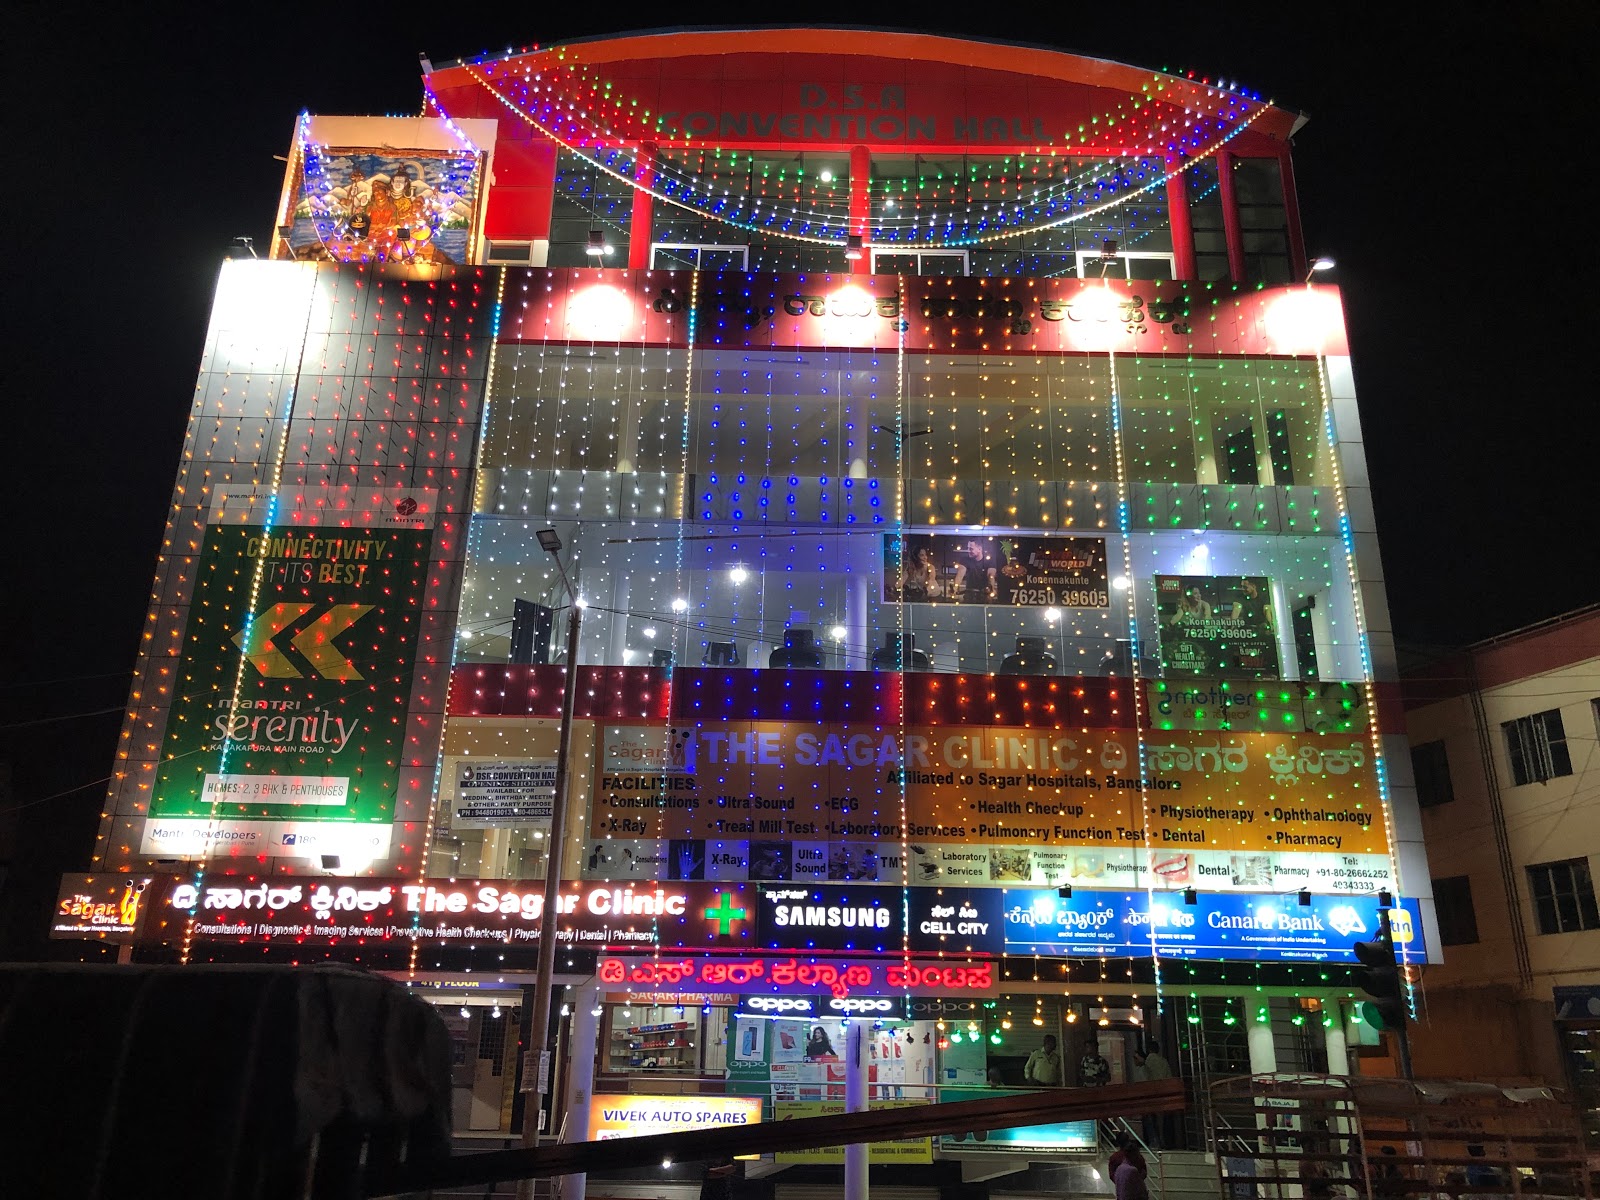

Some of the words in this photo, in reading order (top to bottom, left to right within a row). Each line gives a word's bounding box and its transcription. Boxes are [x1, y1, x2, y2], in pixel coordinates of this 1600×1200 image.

[661, 111, 936, 141] CONVENTION
[954, 116, 1053, 142] HALL
[246, 537, 387, 560] CONNECTIVITY
[1050, 560, 1086, 568] WORLD
[284, 562, 313, 584] ITS
[318, 564, 371, 585] BEST.
[1010, 588, 1055, 604] 76250
[1061, 589, 1107, 606] 39605
[1184, 628, 1217, 638] 76250
[1220, 628, 1253, 638] 39605
[211, 706, 360, 754] serenity
[273, 744, 297, 753] MAIN
[299, 745, 325, 754] ROAD
[608, 745, 665, 762] Sagar
[700, 731, 781, 765] THE
[794, 732, 930, 768] SAGAR
[943, 736, 1079, 771] CLINIC
[1099, 741, 1128, 769] ದಿ
[1268, 741, 1366, 786] ಕ್ಲಿನಿಕ್
[493, 771, 540, 780] CONVENTION
[541, 771, 556, 780] HAL
[602, 777, 696, 791] FACILITIES
[886, 771, 954, 785] Affiliated
[960, 773, 974, 785] to
[978, 773, 1022, 789] Sagar
[1026, 773, 1102, 790] Hospitals,
[1106, 776, 1182, 792] Bangalore
[261, 783, 280, 795] BHK
[281, 784, 288, 795] &
[290, 784, 344, 797] PENTHOUSES
[609, 795, 700, 808] Consultations
[717, 796, 751, 809] Ultra
[754, 796, 795, 810] Sound
[831, 798, 859, 811] ECG
[978, 801, 1022, 814] Health
[1025, 802, 1084, 818] Checkup
[1160, 805, 1255, 822] Physiotherapy
[1273, 808, 1372, 826] Ophthalmology
[608, 819, 647, 835] X-Ray
[717, 820, 755, 833] Tread
[758, 820, 784, 833] Mill
[786, 821, 815, 834] Test
[831, 821, 902, 838] Laboratory
[907, 823, 966, 837] Services
[978, 825, 1050, 841] Pulmonary
[1054, 825, 1112, 840] Function
[1118, 828, 1145, 841] Test
[1162, 828, 1205, 843] Dental
[1276, 831, 1342, 849] Pharmacy
[711, 853, 743, 867] X-Ray
[798, 849, 823, 860] Ultra
[942, 852, 987, 863] Laboratory
[1033, 851, 1068, 861] Pulmonary
[1342, 857, 1359, 866] Tel:
[795, 862, 826, 874] Sound
[947, 866, 983, 876] Services
[1036, 862, 1065, 870] Function
[1198, 864, 1230, 876] Dental
[1274, 865, 1310, 878] Pharmacy
[74, 894, 93, 903] The
[204, 883, 302, 910] ಸಾಗರ್
[310, 884, 393, 920] ಕ್ಲಿನಿಕ್
[402, 886, 467, 914] The
[476, 886, 580, 920] Sagr
[587, 887, 687, 916] Clinic
[59, 899, 116, 920] Sagar
[774, 905, 890, 928] SAMSUNG
[91, 915, 120, 924] Clinic
[920, 920, 956, 935] CELL
[957, 922, 989, 935] CITY
[1207, 911, 1274, 930] Canara
[1277, 912, 1325, 931] Bank
[194, 923, 252, 934] Consultations
[258, 923, 303, 936] Diagnostic
[314, 925, 347, 937] Imaging
[348, 925, 384, 937] Services
[435, 927, 462, 938] Health
[463, 927, 507, 940] Check-ups
[580, 930, 607, 940] Dental
[613, 930, 655, 942] Pharmacy
[885, 961, 993, 990] ಮಂಟಪ
[679, 992, 733, 1002] PHARMA
[748, 997, 810, 1011] oppo
[829, 998, 893, 1013] oppo
[912, 1001, 973, 1013] oppo
[730, 1060, 768, 1068] oppo
[603, 1110, 647, 1122] VIVEK
[651, 1111, 692, 1123] AUTO
[695, 1112, 747, 1124] SPARES
